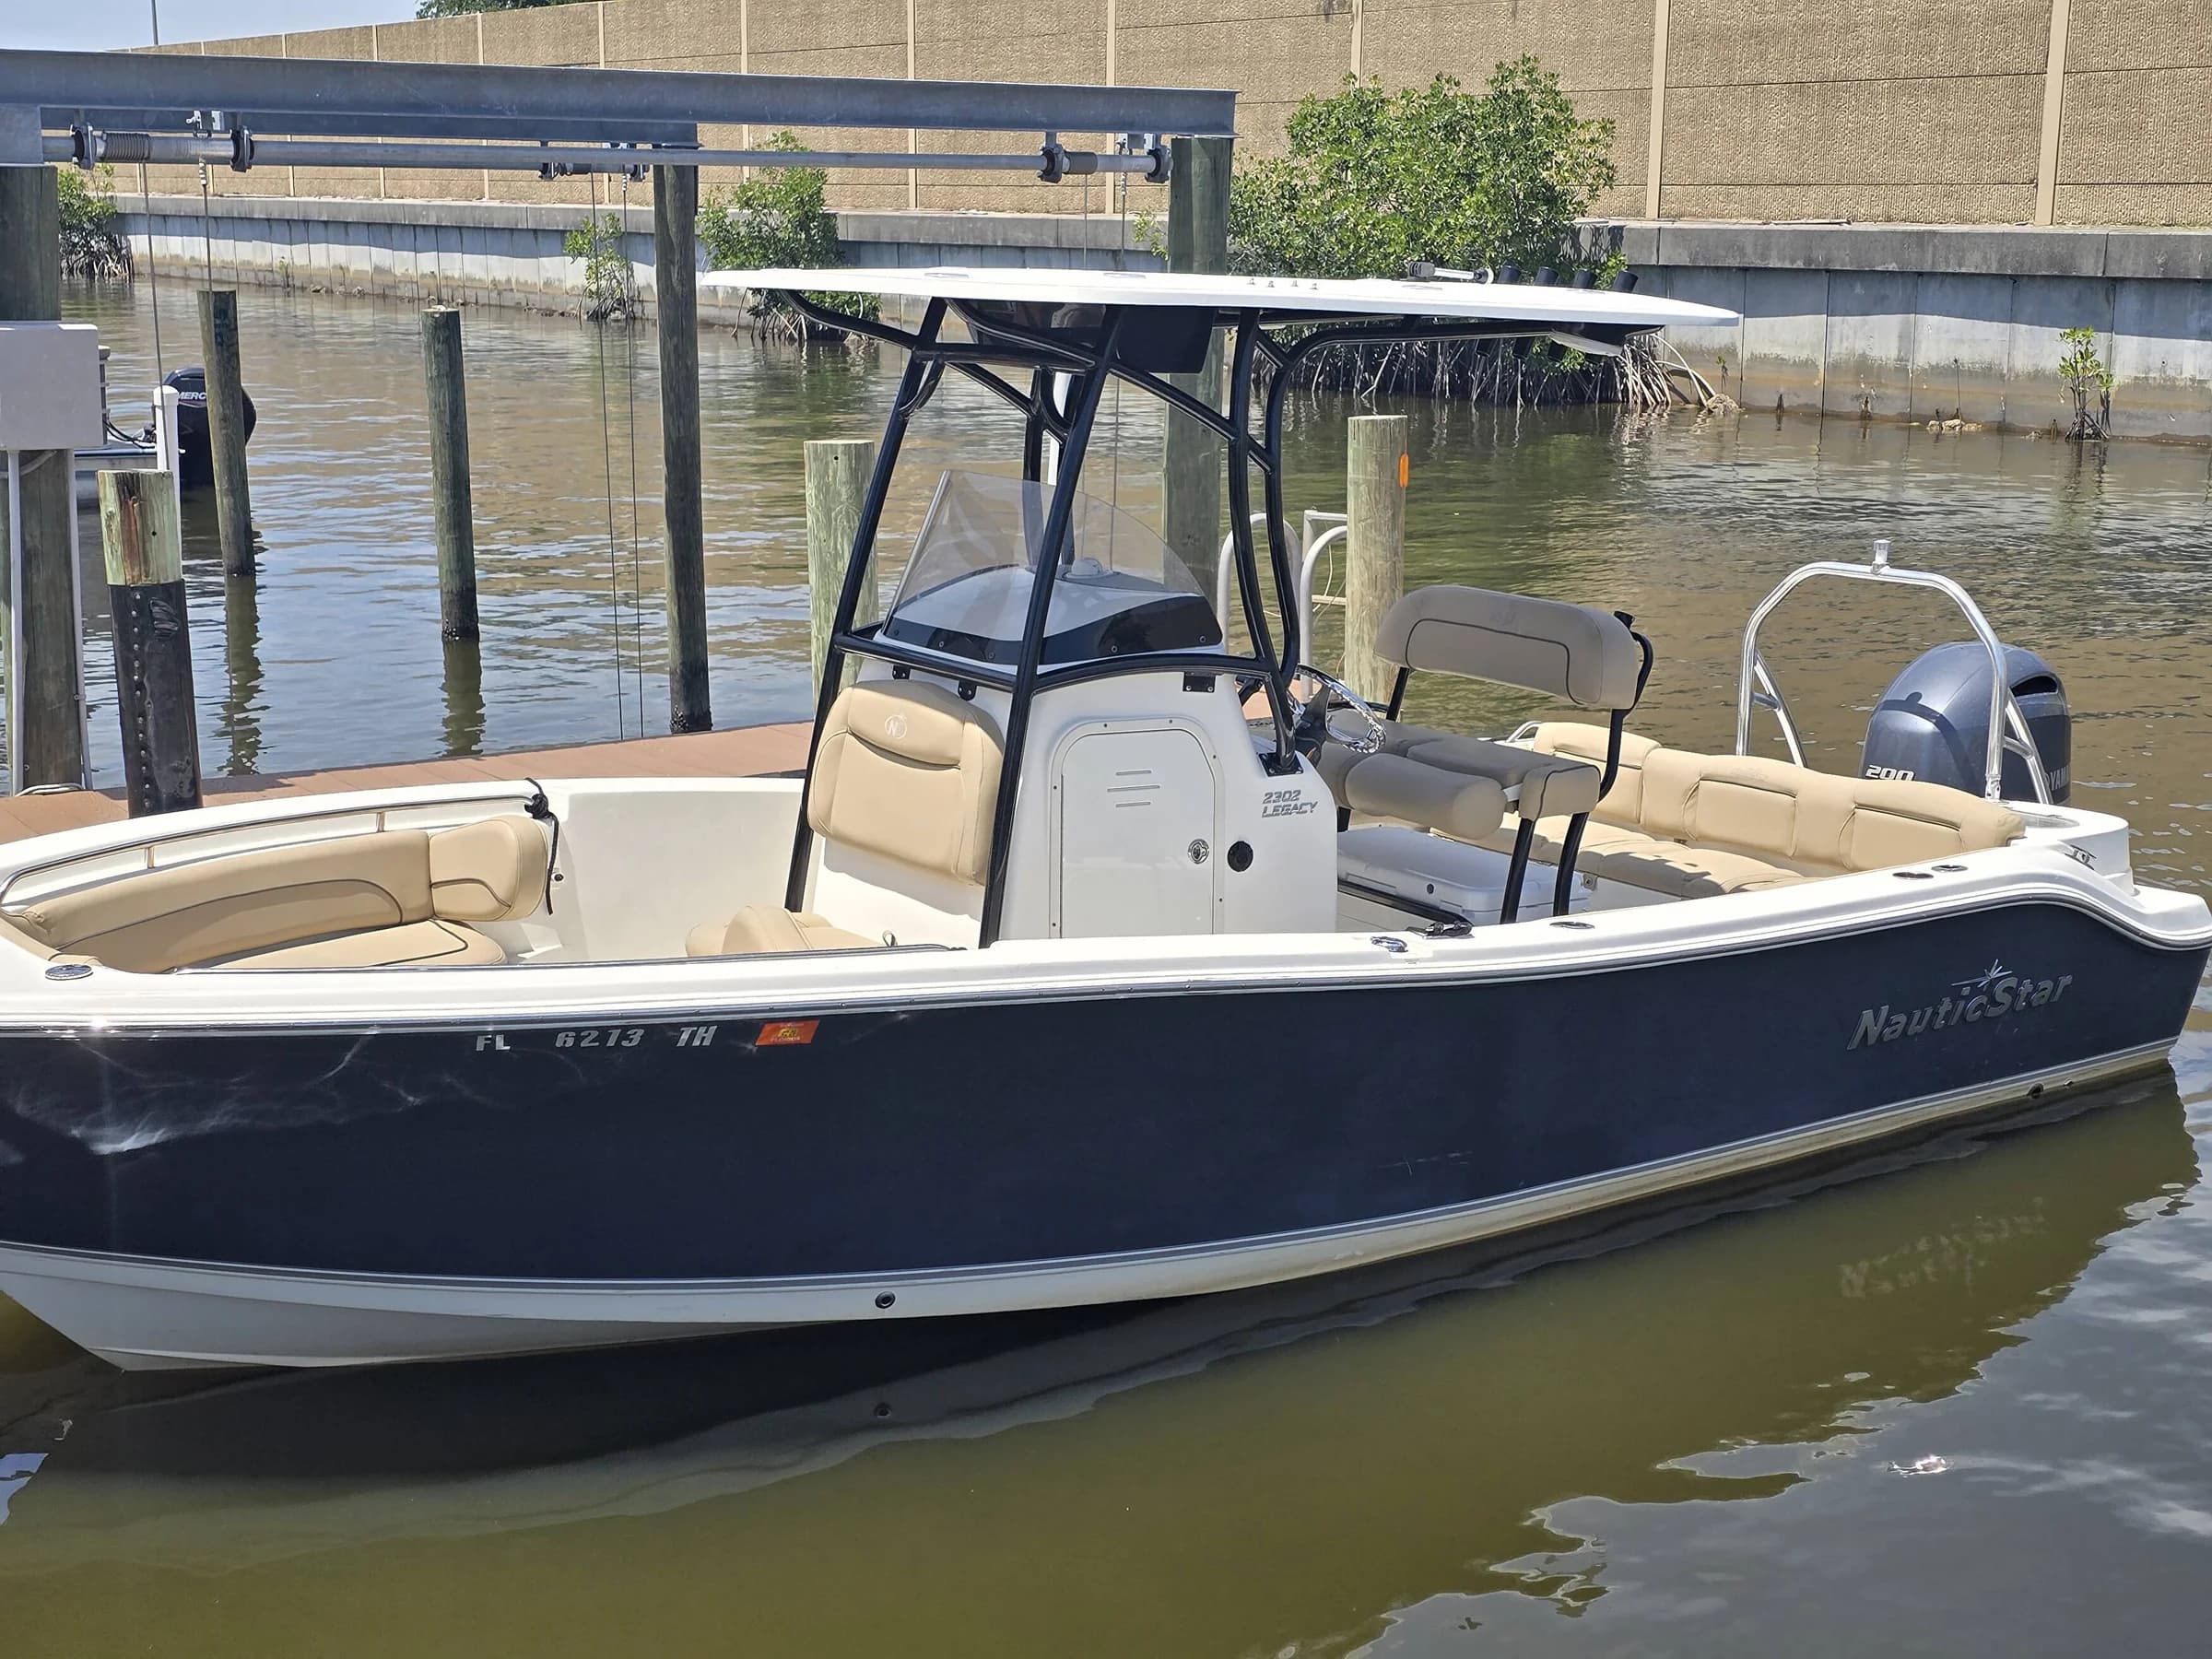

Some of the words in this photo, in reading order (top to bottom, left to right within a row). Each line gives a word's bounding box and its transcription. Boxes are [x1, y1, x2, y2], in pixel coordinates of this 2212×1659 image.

[178, 391, 207, 400] MERC
[1865, 764, 1914, 781] 200
[2050, 765, 2069, 791] YAM
[1263, 790, 1301, 804] 2302
[1262, 802, 1318, 818] LEGACY
[1846, 974, 2073, 1051] NauticStar
[476, 1035, 512, 1052] FL
[555, 1028, 645, 1048] 6213
[676, 1025, 720, 1047] TH
